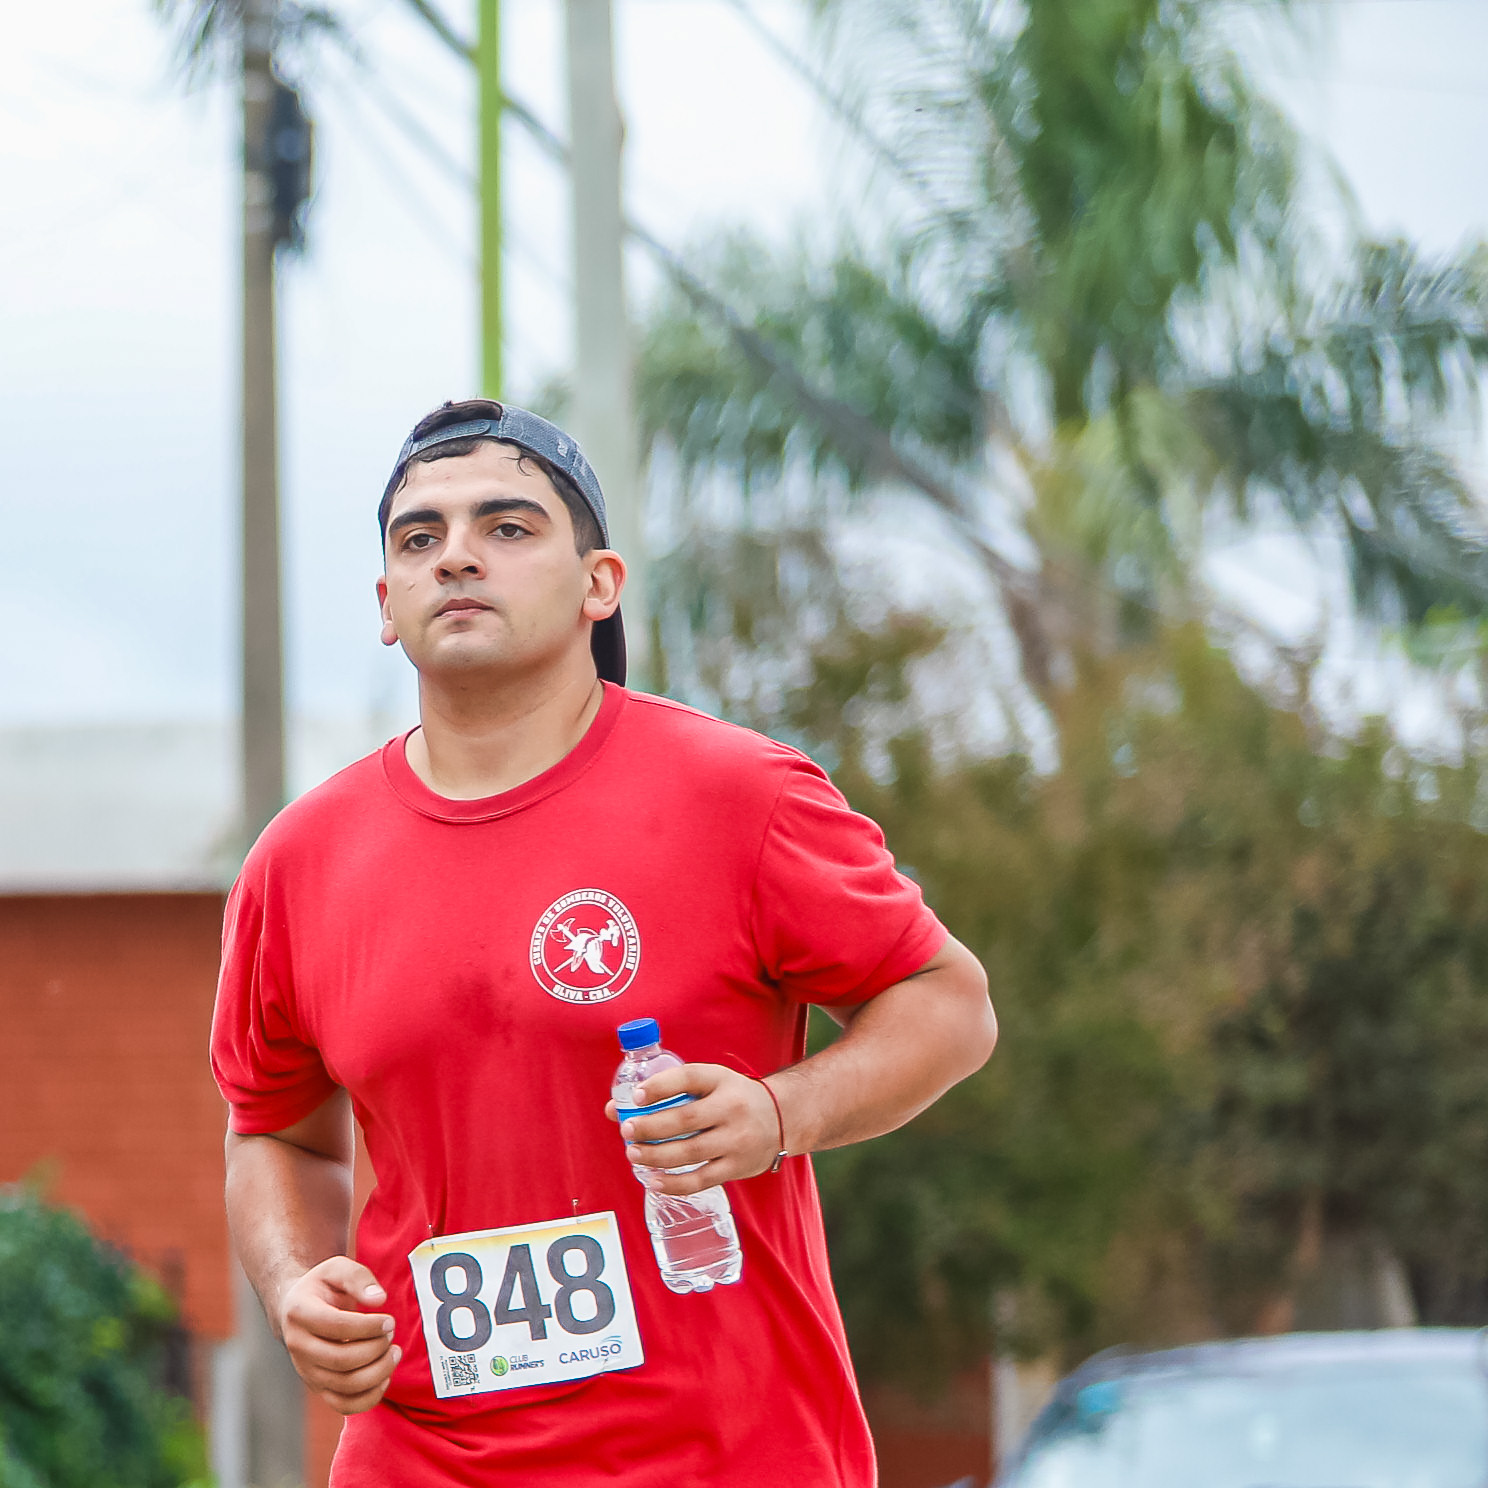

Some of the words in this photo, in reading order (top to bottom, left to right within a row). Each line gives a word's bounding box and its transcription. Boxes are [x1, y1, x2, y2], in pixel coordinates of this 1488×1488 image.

[429, 1234, 616, 1353] 848
[509, 1354, 529, 1363] CLUB
[559, 1343, 622, 1364] CARUSO
